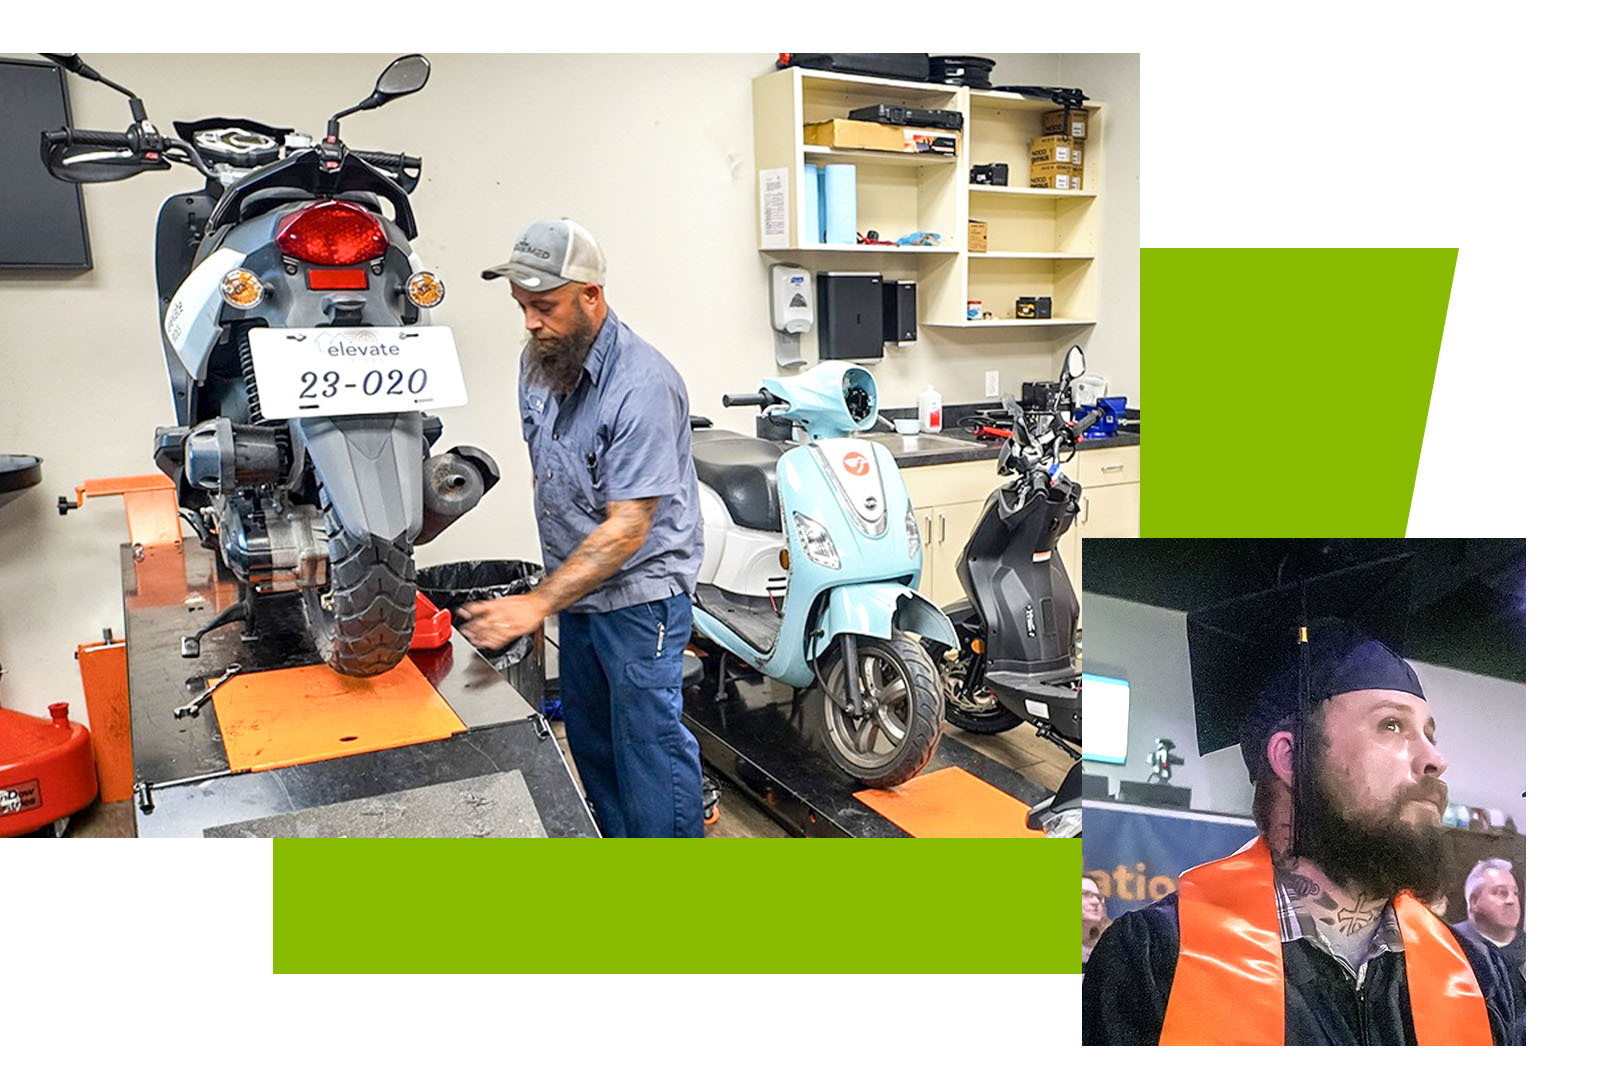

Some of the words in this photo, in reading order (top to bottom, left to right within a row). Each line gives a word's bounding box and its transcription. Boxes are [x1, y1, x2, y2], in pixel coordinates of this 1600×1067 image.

[328, 341, 400, 357] elevate
[298, 368, 428, 399] 23-020
[1085, 861, 1177, 901] atio
